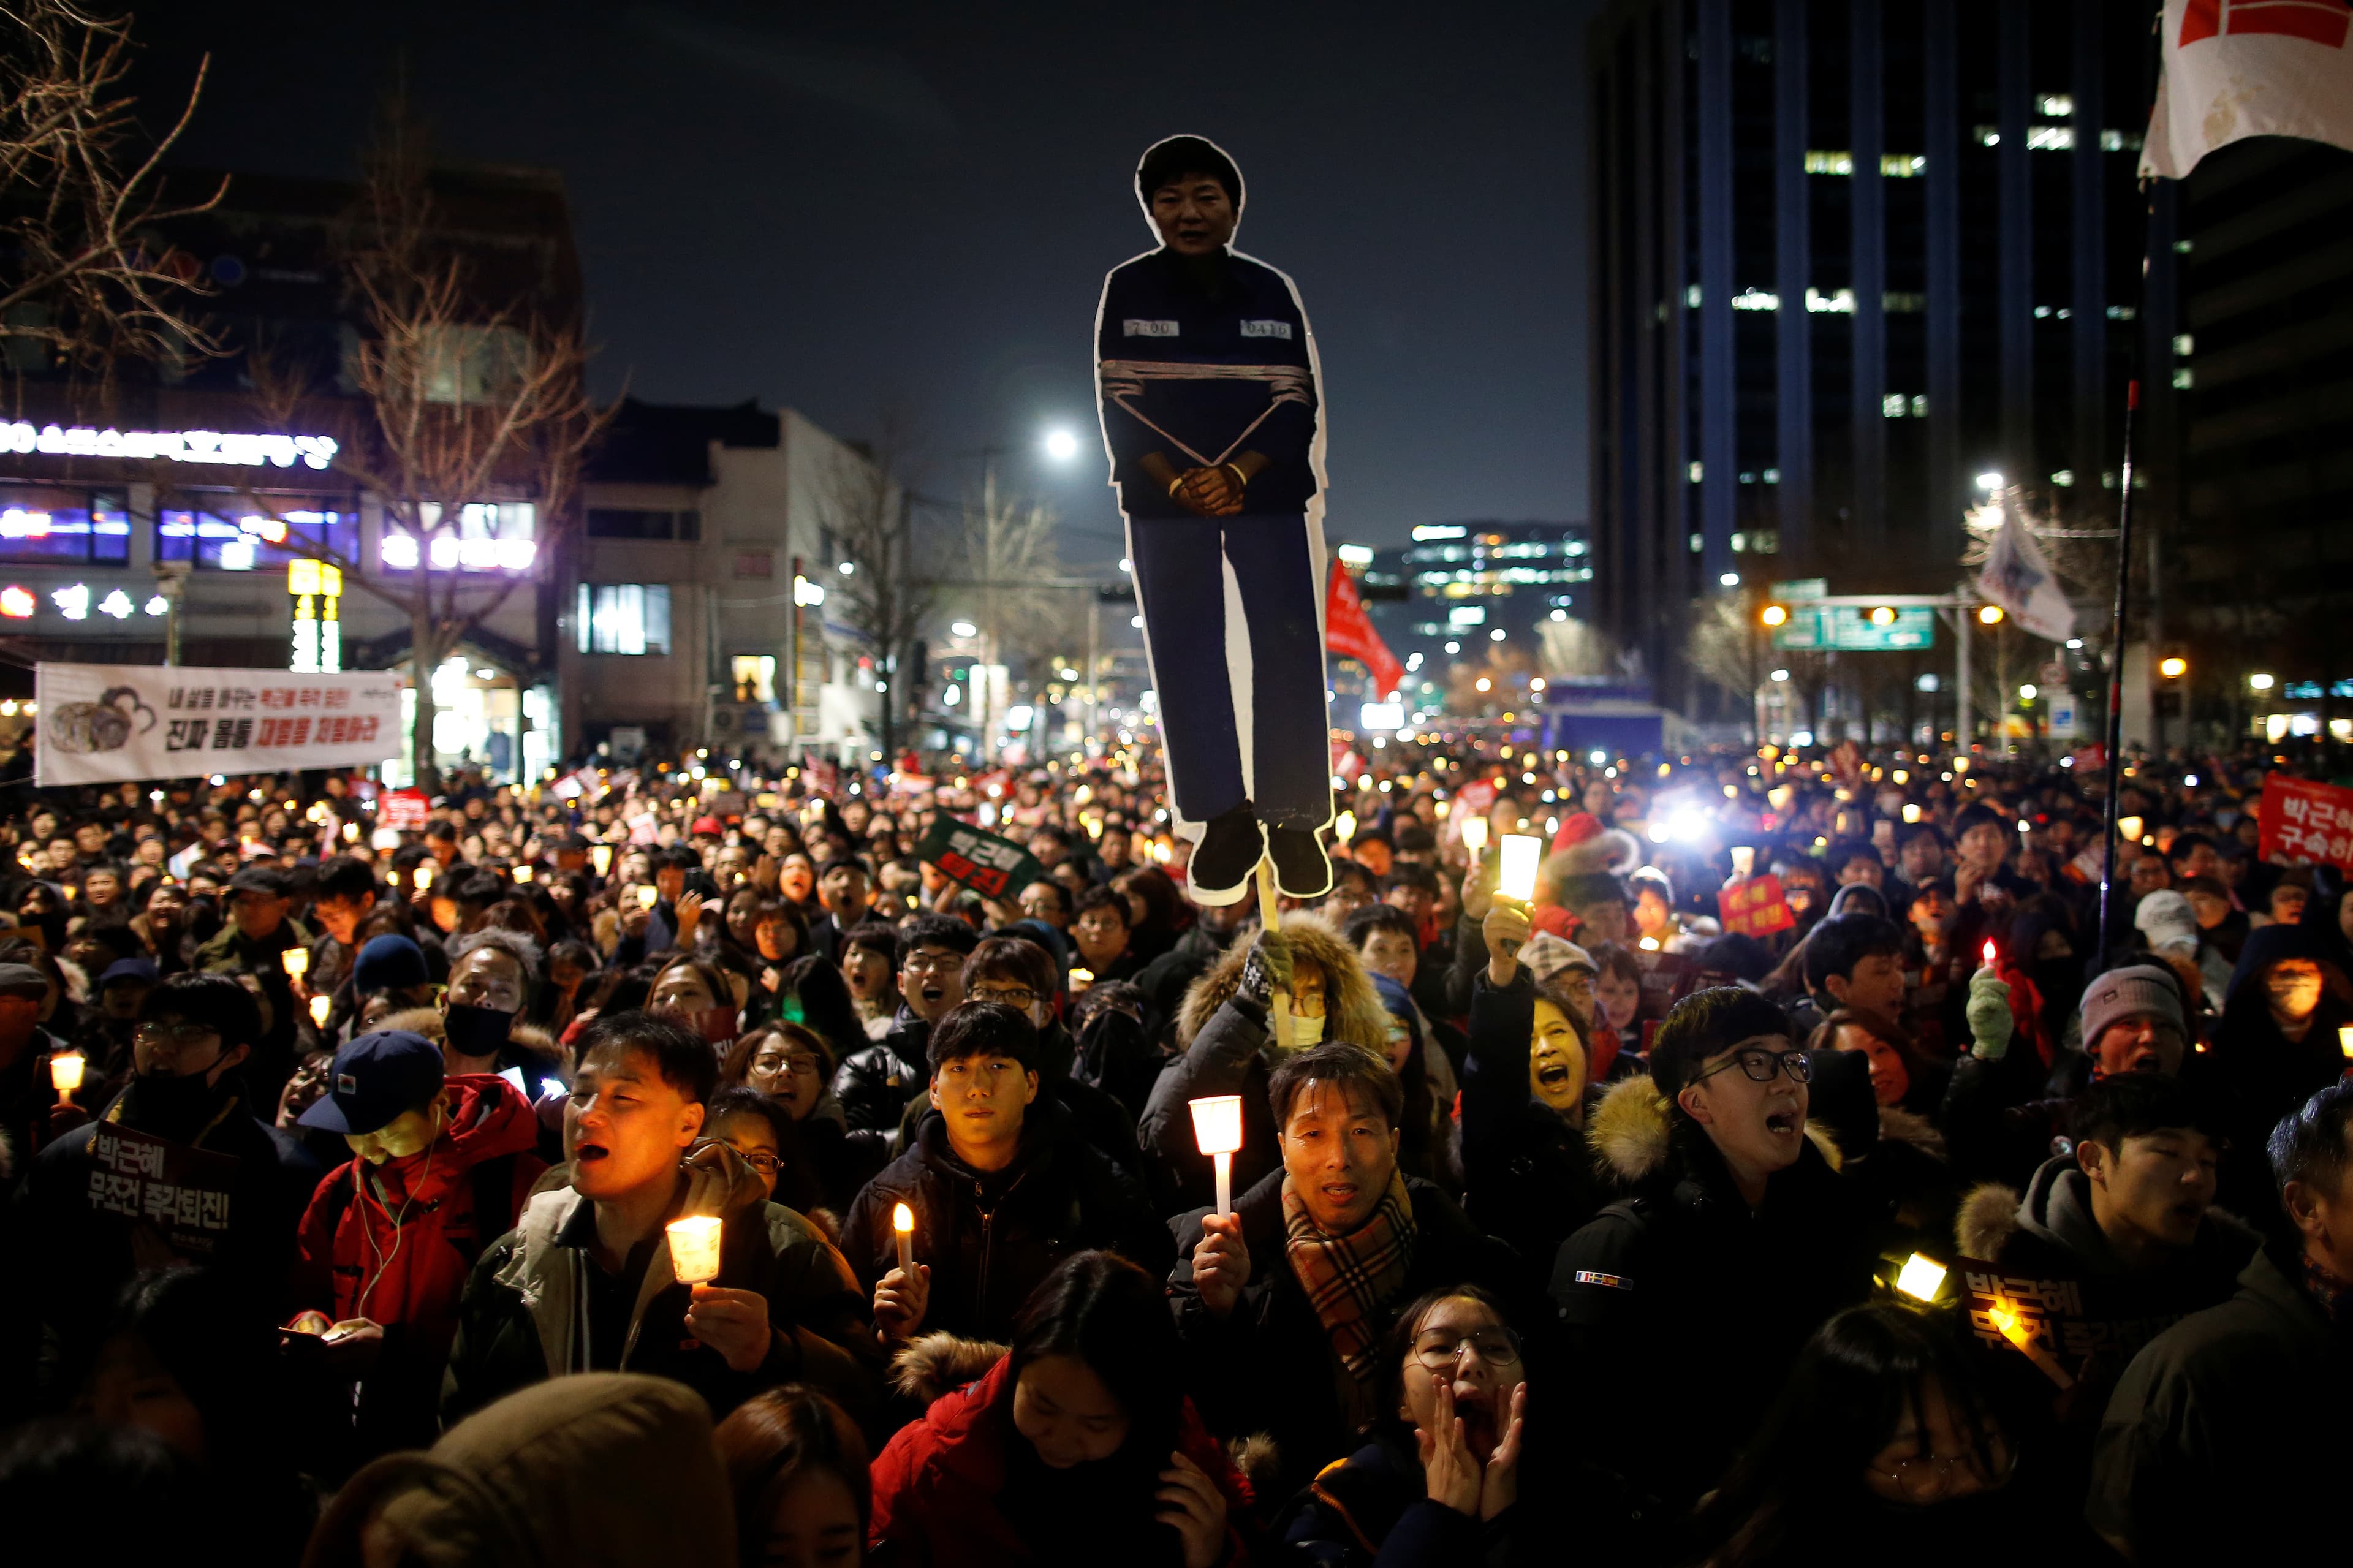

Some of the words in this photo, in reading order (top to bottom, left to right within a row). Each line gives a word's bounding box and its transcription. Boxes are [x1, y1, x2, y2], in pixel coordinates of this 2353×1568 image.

[97, 1134, 165, 1180] 박근혜
[88, 1170, 141, 1218] 무조건
[143, 1182, 229, 1230] 즉각퇴진!
[1965, 1271, 2083, 1316] 박근혜
